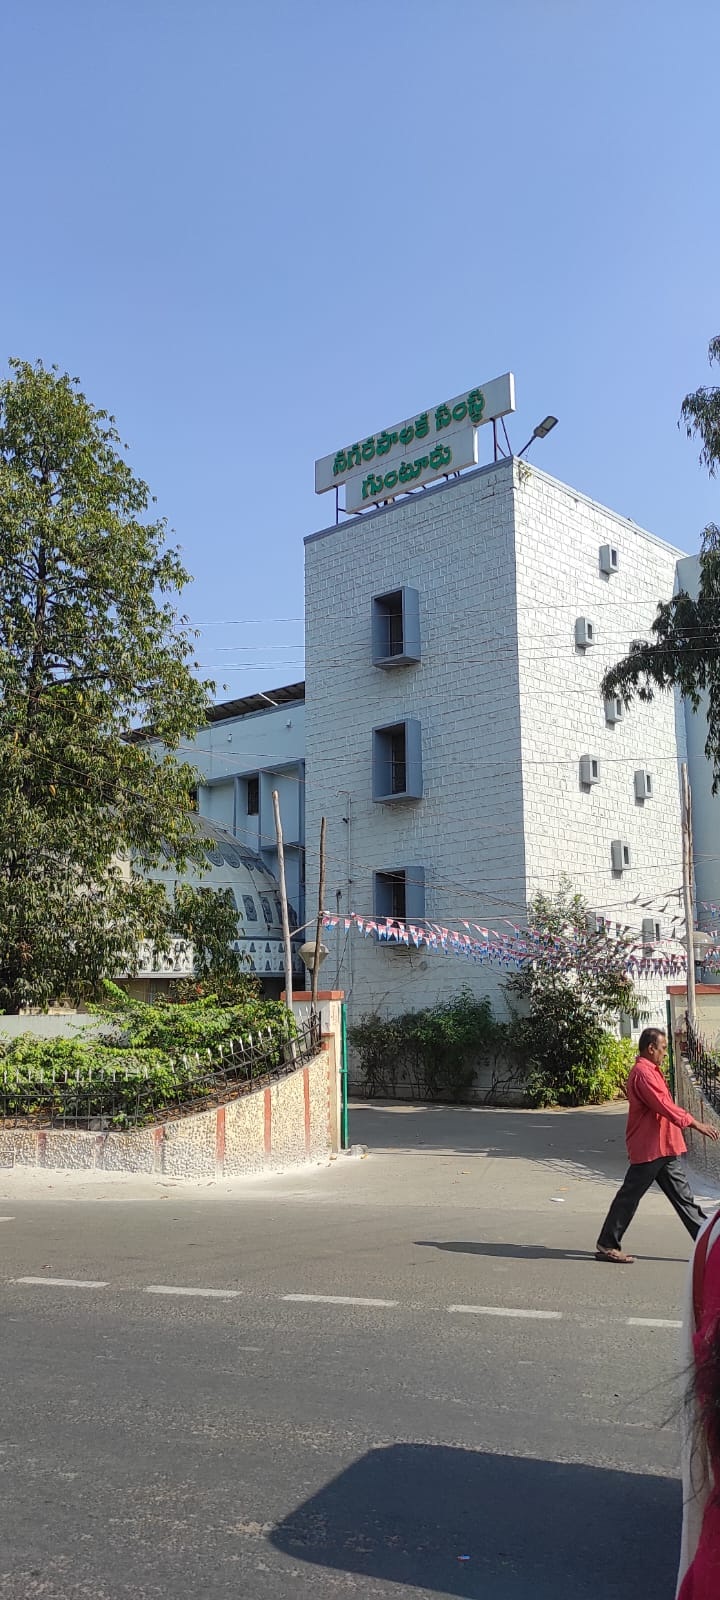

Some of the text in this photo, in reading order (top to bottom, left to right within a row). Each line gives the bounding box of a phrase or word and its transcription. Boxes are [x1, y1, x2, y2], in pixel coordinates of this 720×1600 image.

[333, 389, 485, 476] నగరపాలక సంస్థ
[362, 443, 452, 499] గుంటూరు
